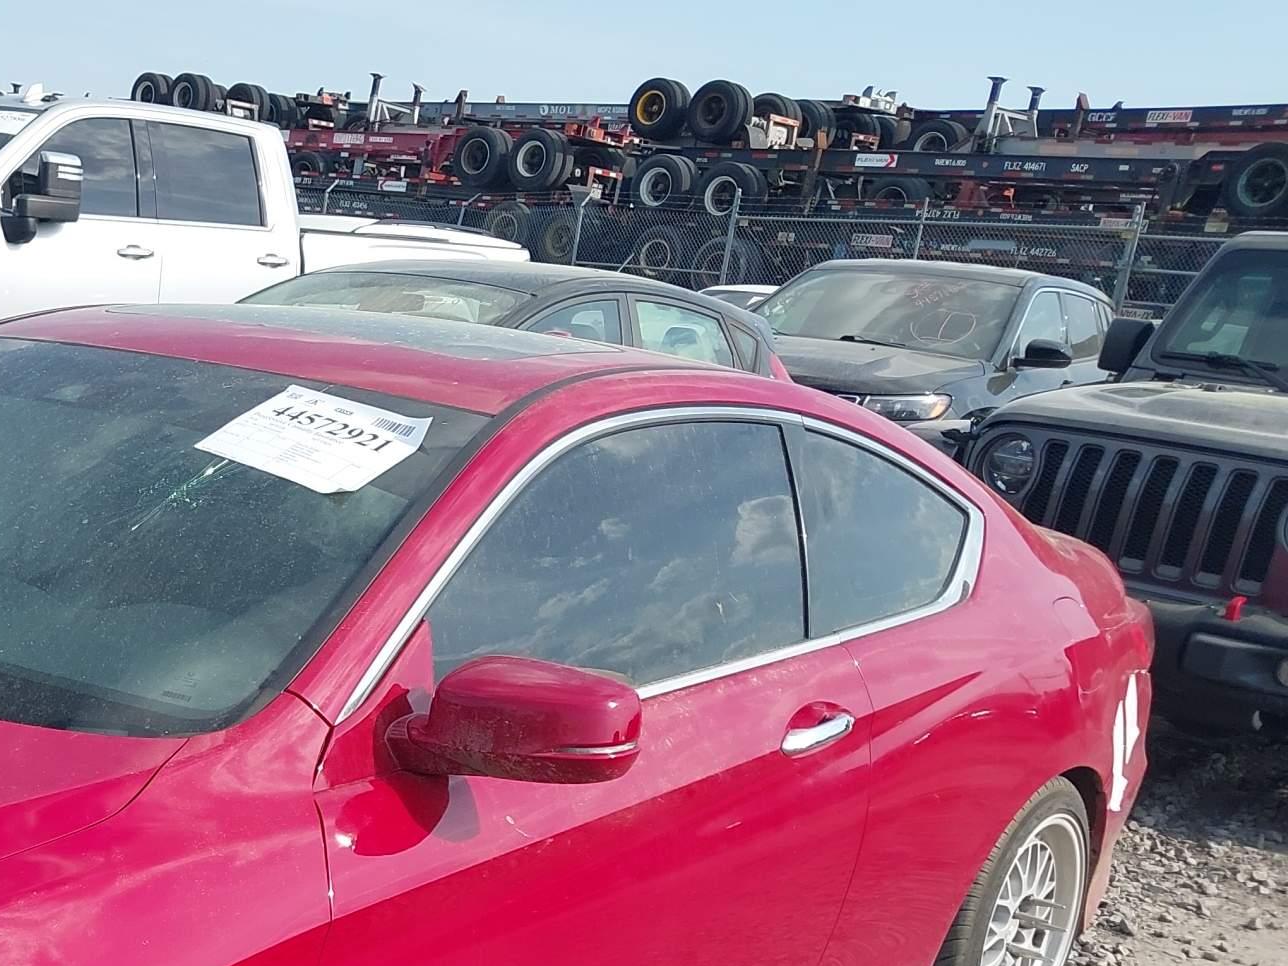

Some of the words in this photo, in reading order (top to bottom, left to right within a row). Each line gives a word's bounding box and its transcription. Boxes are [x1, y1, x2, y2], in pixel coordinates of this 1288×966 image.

[550, 105, 573, 115] MOL
[1148, 111, 1191, 121] FLEXI-VAN
[1003, 161, 1022, 171] FLXZ
[1070, 163, 1089, 173] SACP
[271, 405, 393, 452] 44572921
